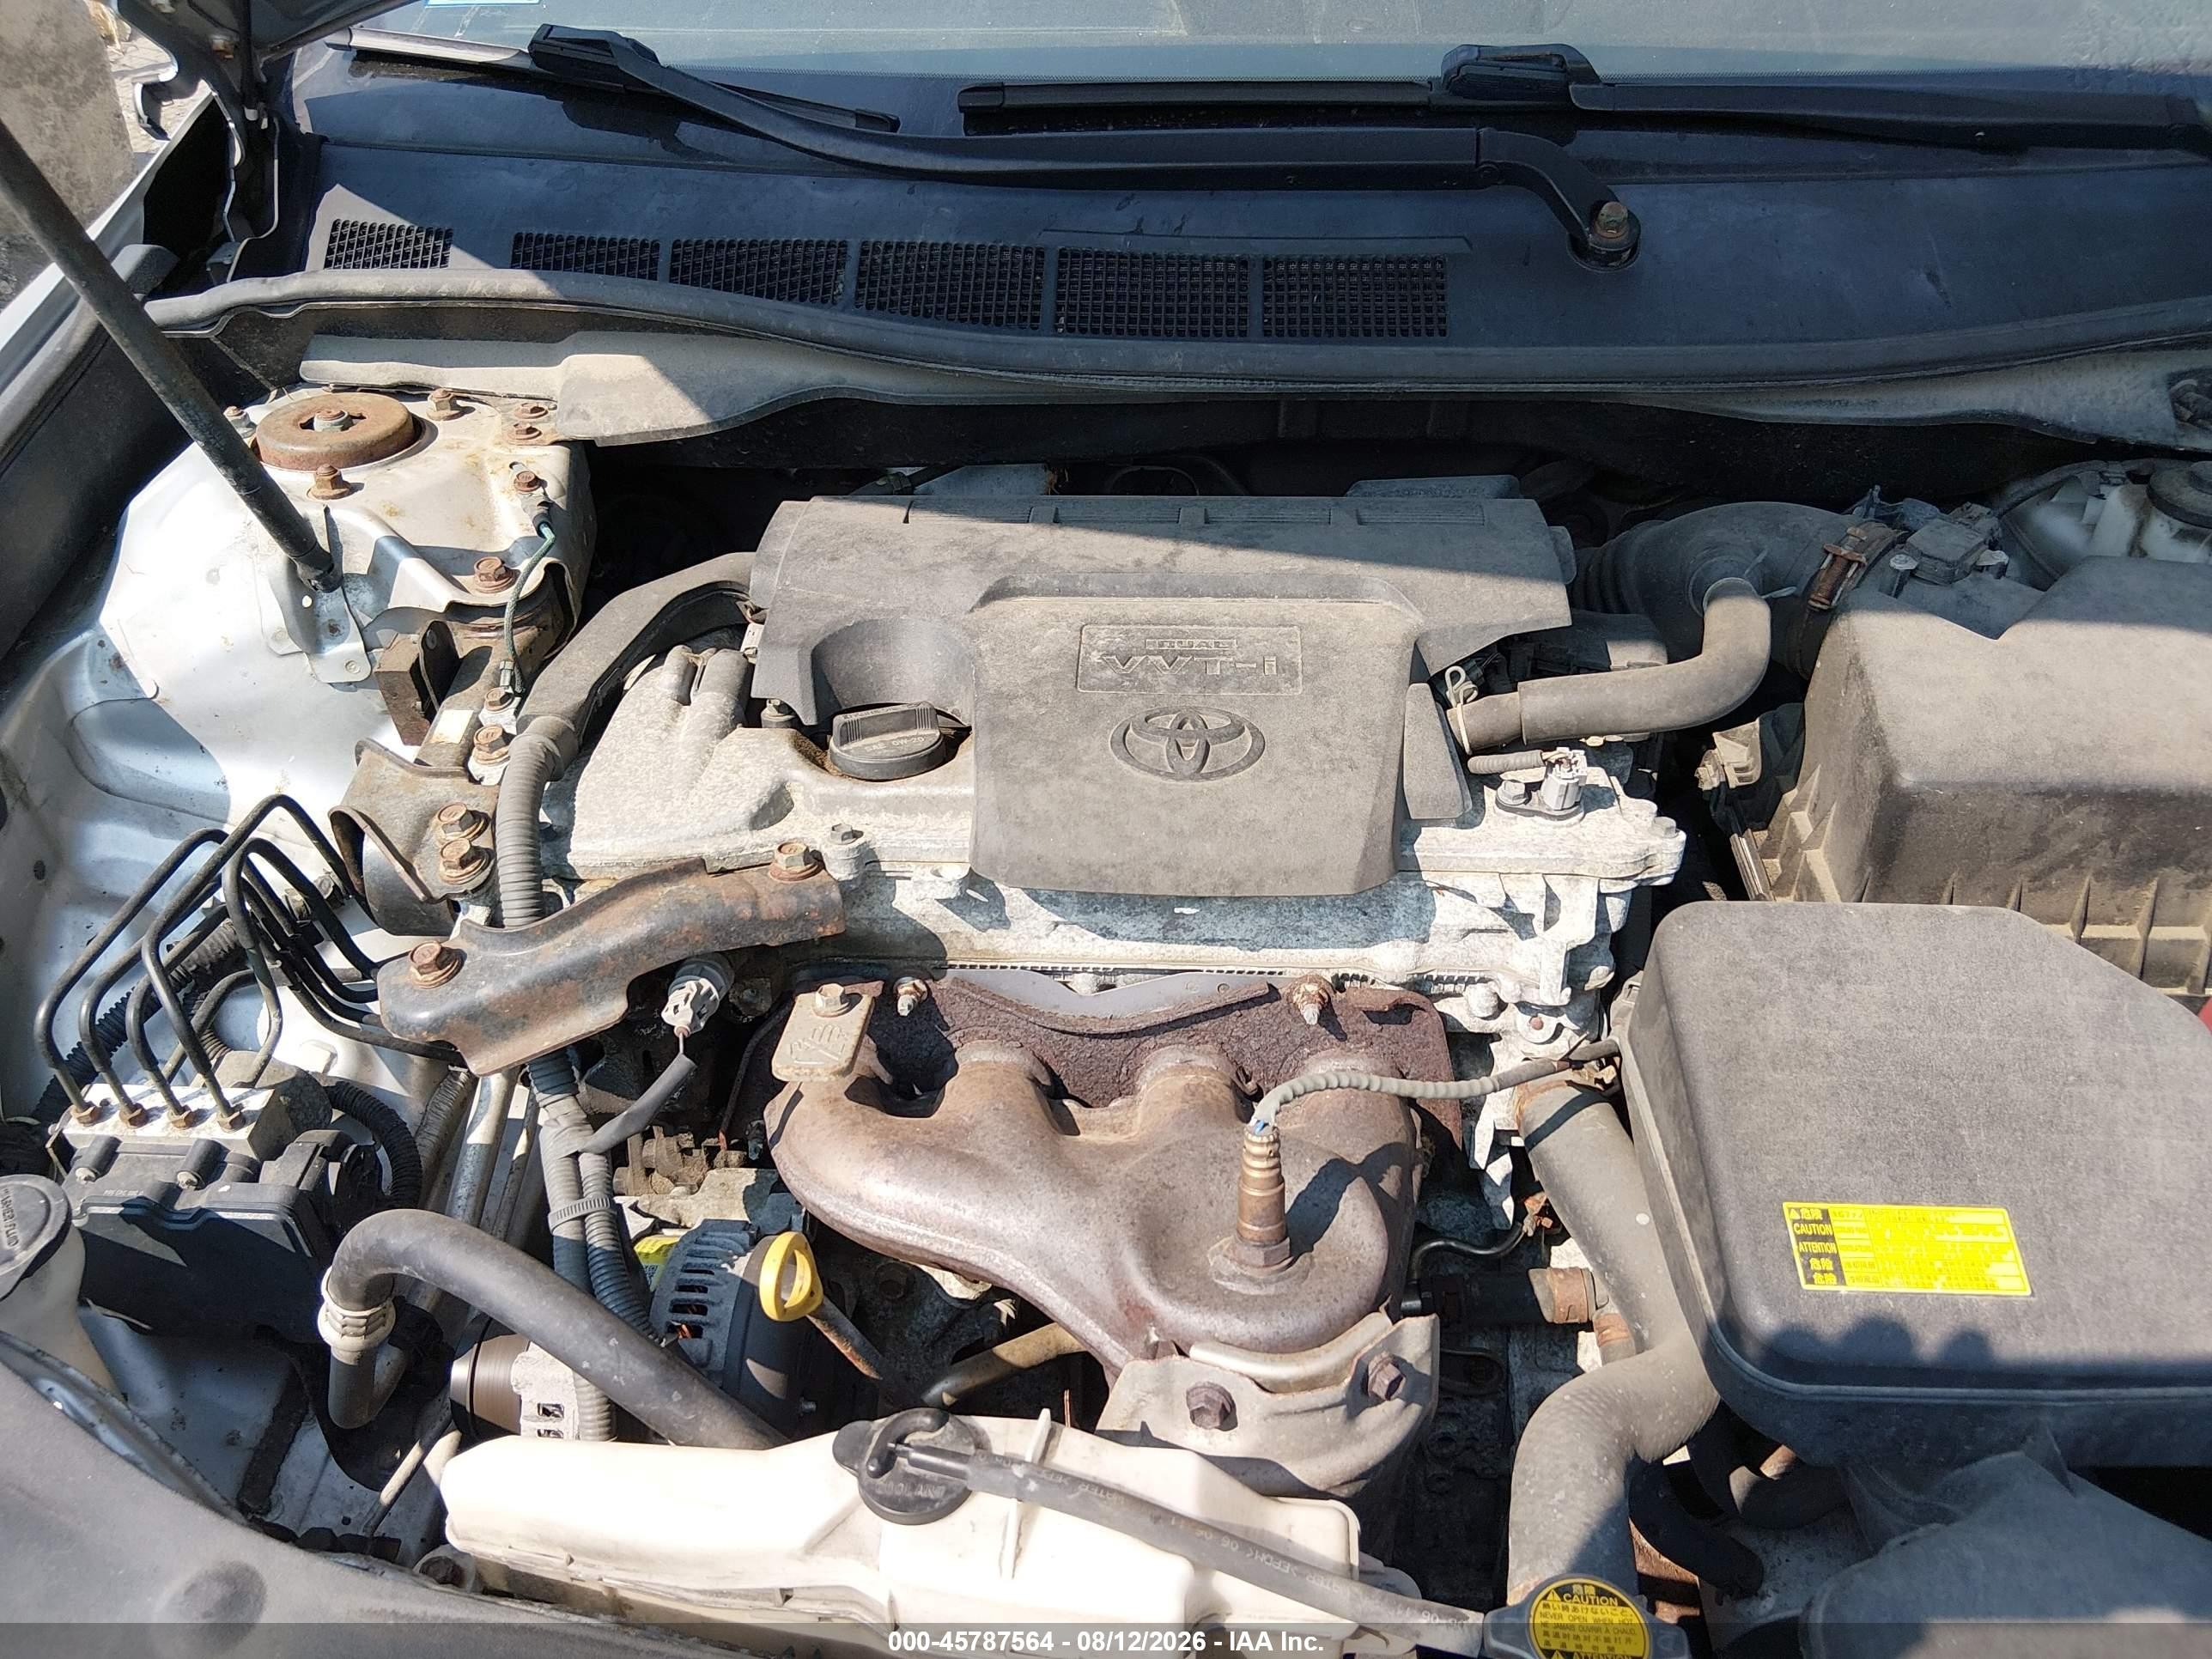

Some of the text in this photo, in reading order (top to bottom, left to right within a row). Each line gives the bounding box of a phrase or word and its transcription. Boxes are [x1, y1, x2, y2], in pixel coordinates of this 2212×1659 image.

[1793, 1223, 1833, 1236] CAUTION
[1798, 1241, 1838, 1254] ATTENTION
[1563, 1593, 1619, 1607] CAUTION
[1540, 1611, 1564, 1621] NEVER
[1568, 1613, 1588, 1623] OPEN
[1593, 1616, 1613, 1625] WHEN
[1540, 1620, 1550, 1629] NE
[1553, 1623, 1576, 1632] JAMAIS
[1578, 1626, 1603, 1634] OUVRIR
